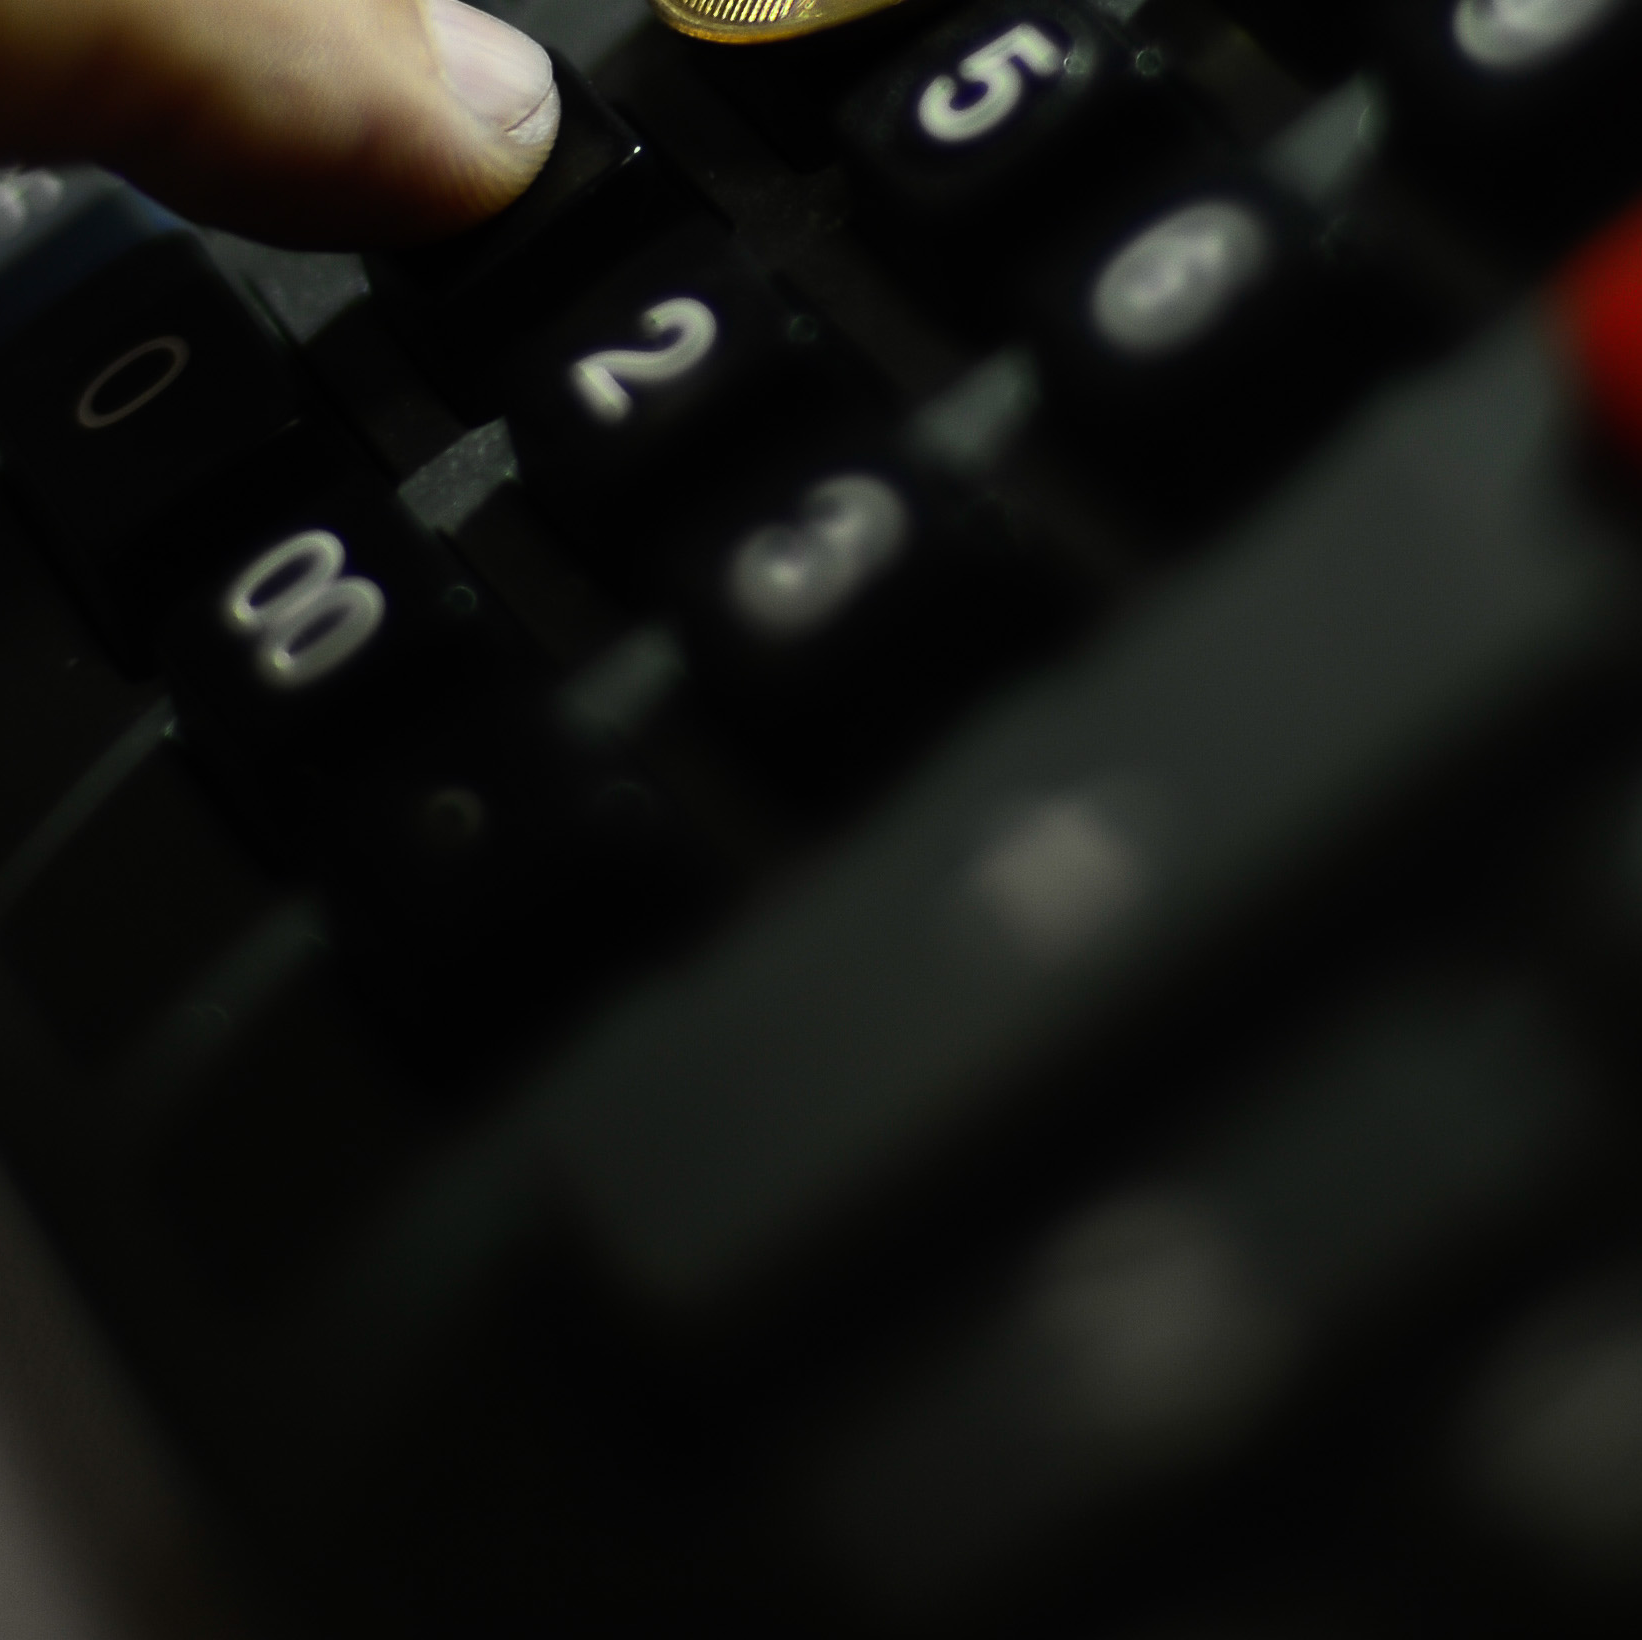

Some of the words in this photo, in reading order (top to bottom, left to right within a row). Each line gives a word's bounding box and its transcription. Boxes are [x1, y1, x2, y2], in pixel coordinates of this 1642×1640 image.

[917, 22, 1059, 142] 5
[74, 334, 191, 430] 0
[571, 296, 717, 420] 2
[730, 473, 905, 628] 3
